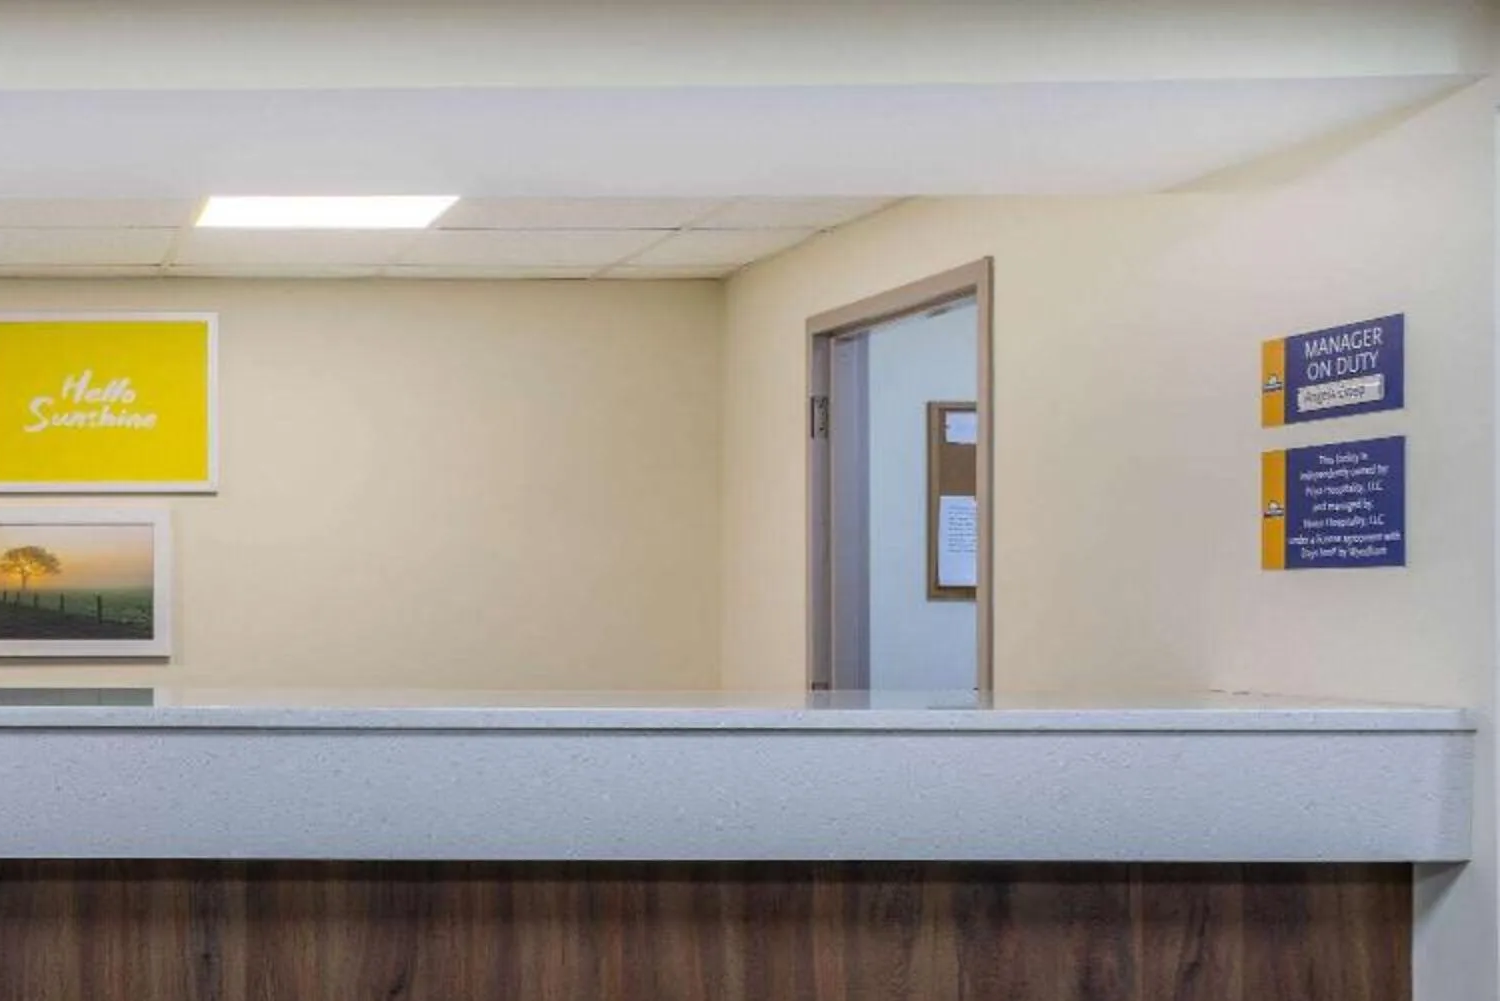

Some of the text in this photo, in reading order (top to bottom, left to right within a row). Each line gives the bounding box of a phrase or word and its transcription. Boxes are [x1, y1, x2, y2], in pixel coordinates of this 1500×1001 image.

[1305, 327, 1383, 359] MANAGER
[1307, 349, 1379, 381] ON DUTY
[62, 369, 137, 404] Hello
[23, 397, 158, 432] Sunshine
[1369, 514, 1385, 525] LLC
